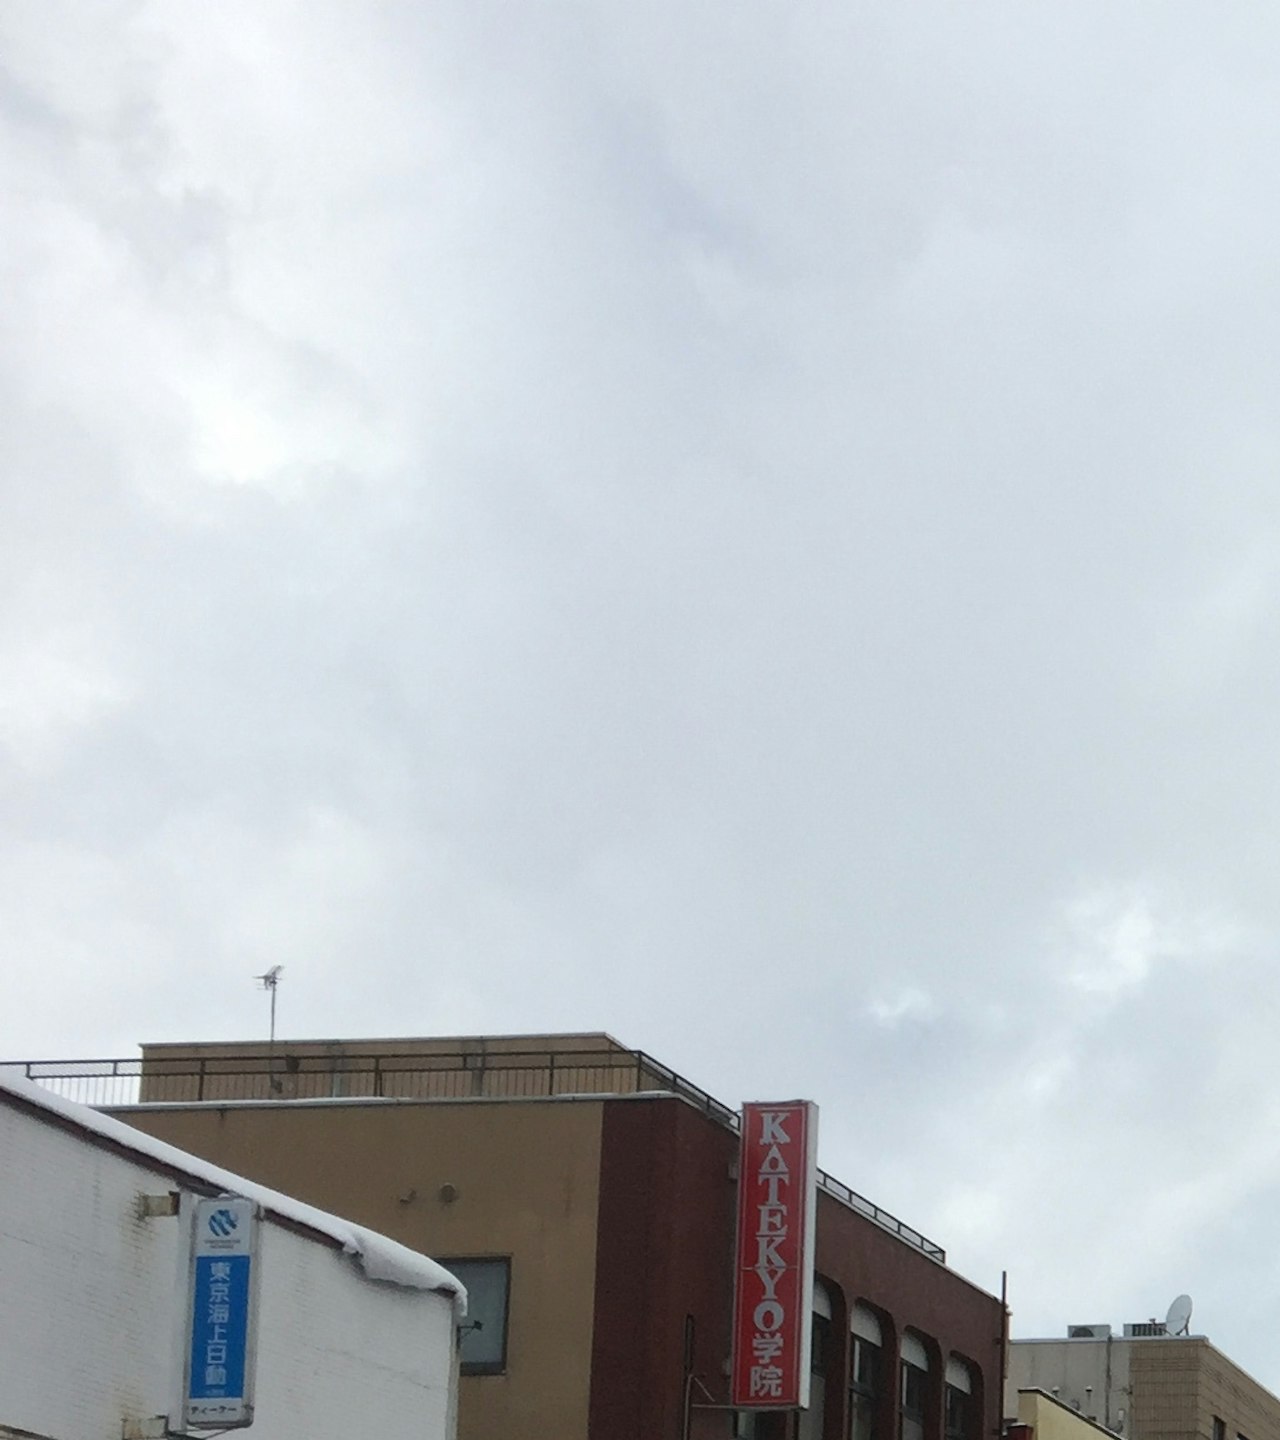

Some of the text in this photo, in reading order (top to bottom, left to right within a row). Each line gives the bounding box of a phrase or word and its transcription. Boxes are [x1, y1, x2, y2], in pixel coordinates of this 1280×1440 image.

[204, 1261, 232, 1386] 東京海上日動
[754, 1112, 791, 1398] KATEKYO学院
